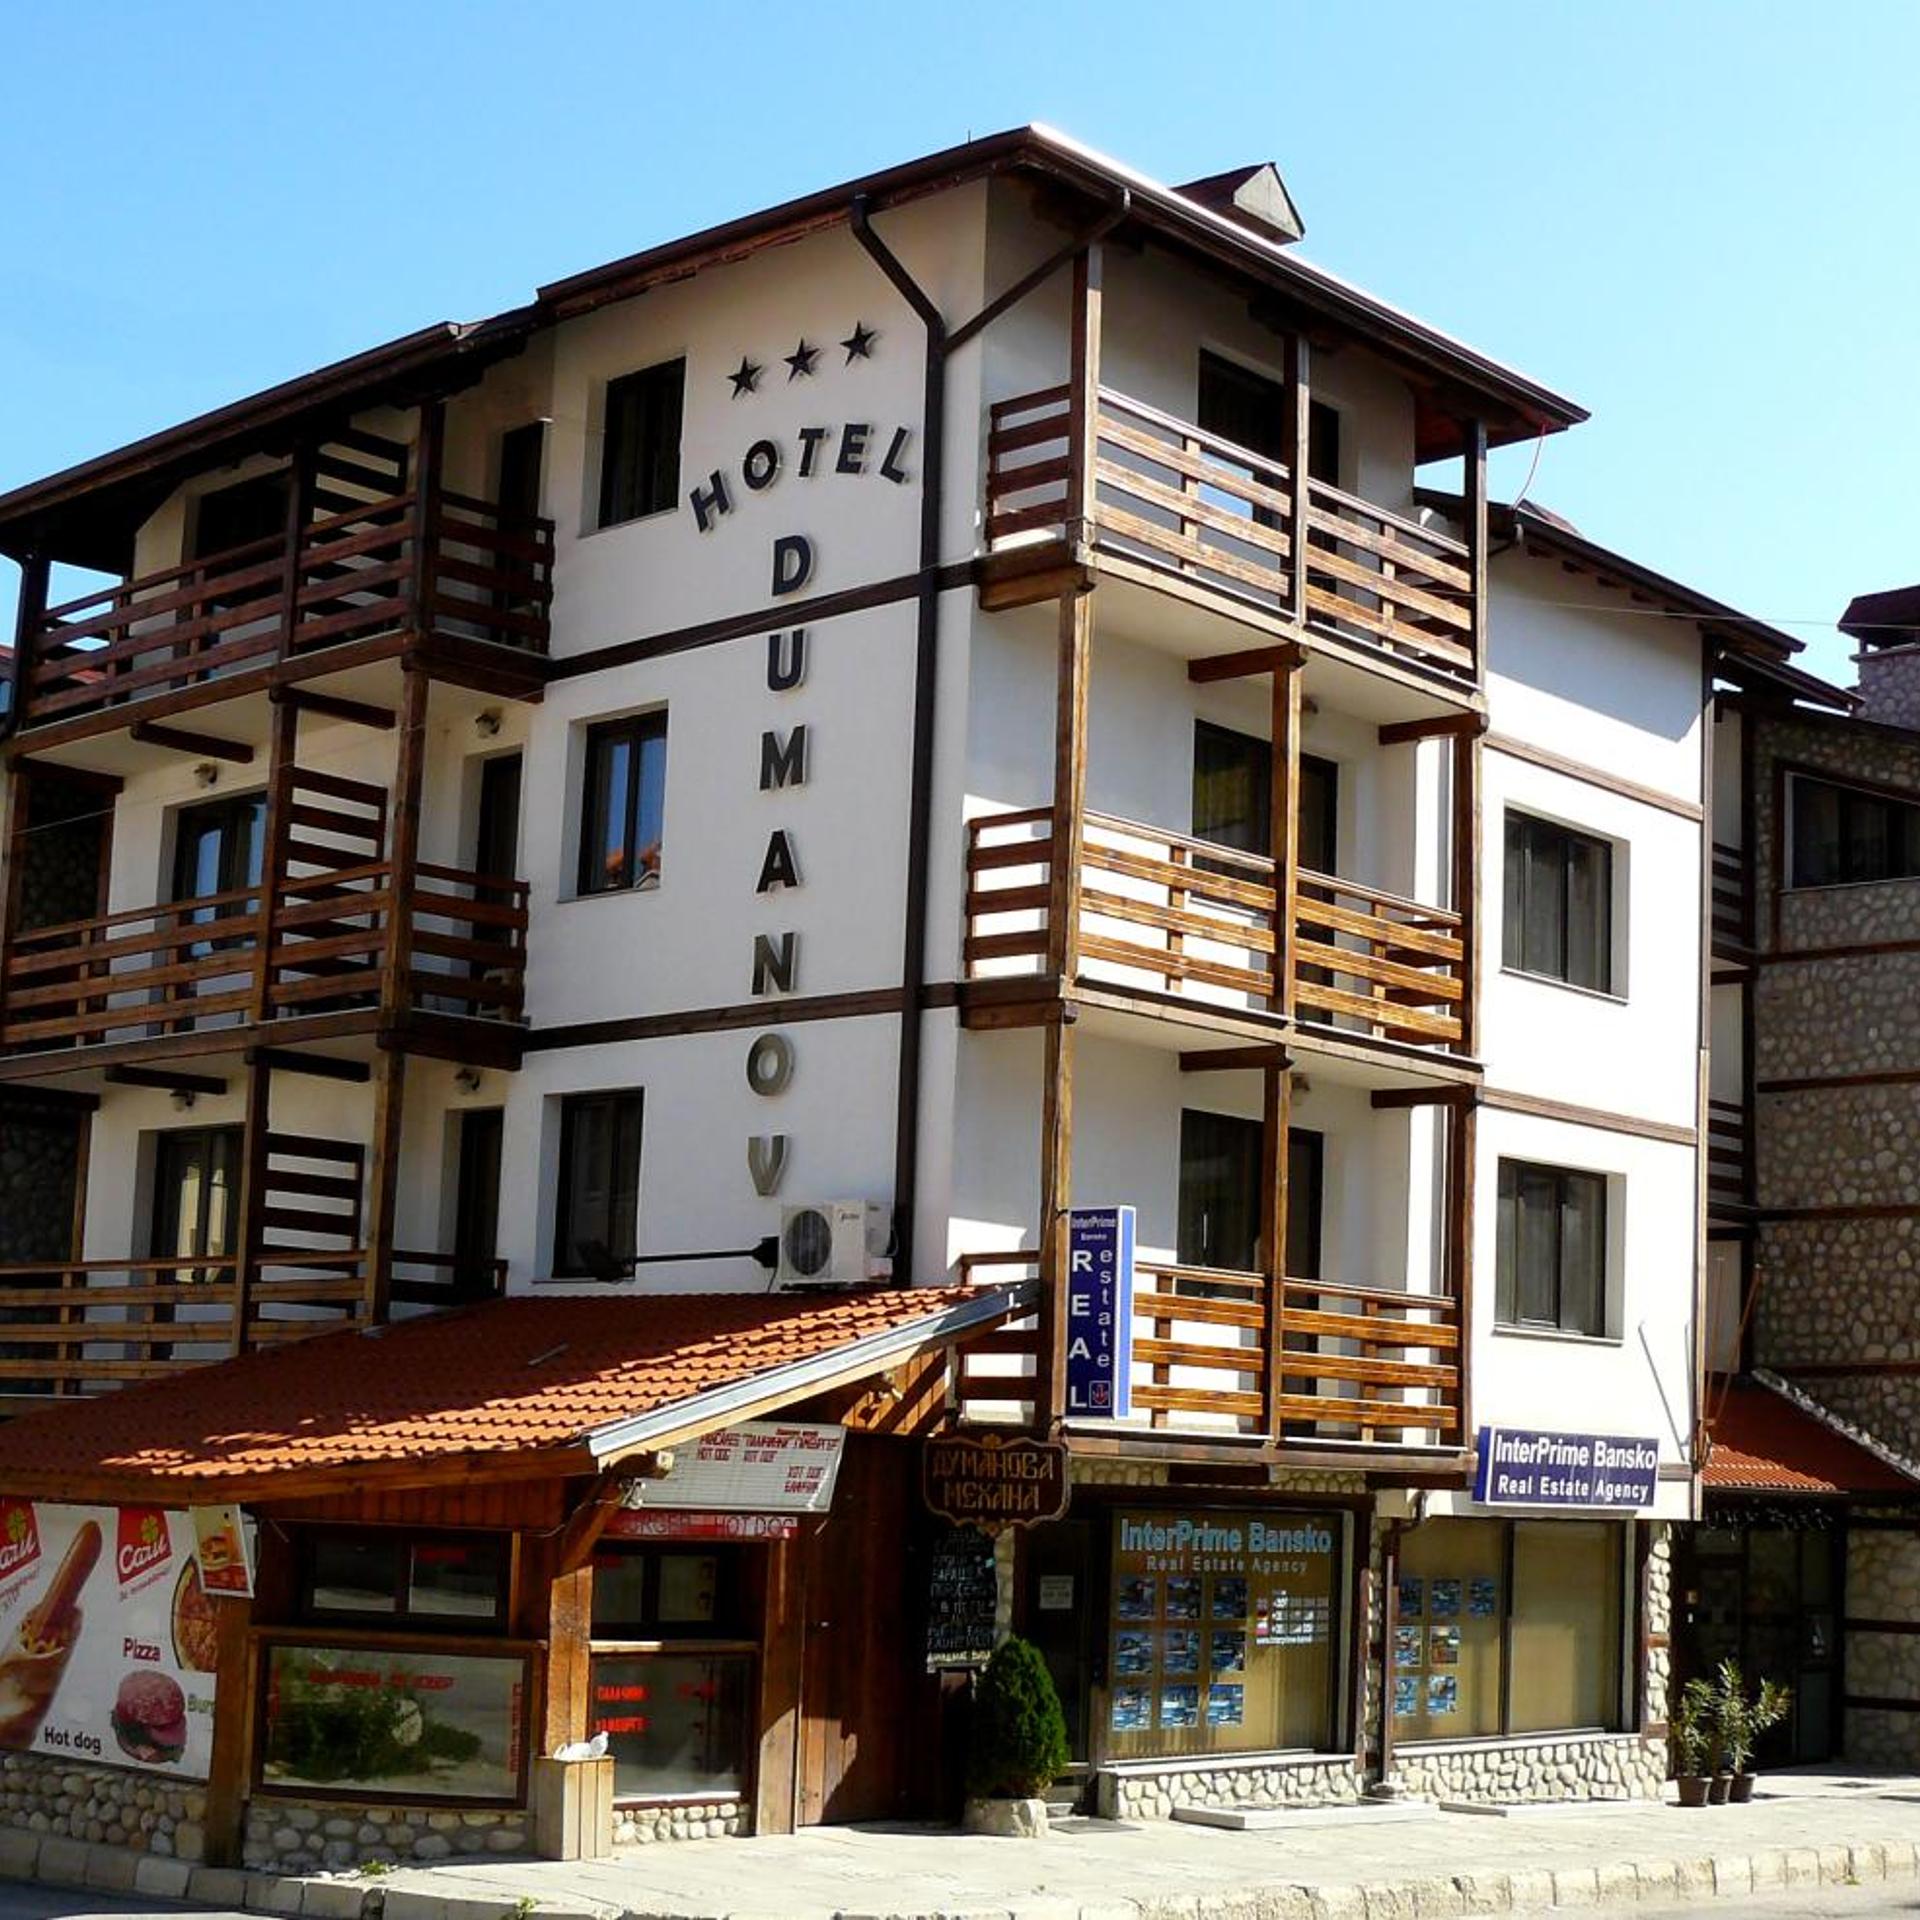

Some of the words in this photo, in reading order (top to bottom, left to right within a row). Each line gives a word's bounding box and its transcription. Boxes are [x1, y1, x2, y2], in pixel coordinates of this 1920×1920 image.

[689, 423, 909, 533] HOTEL
[747, 534, 812, 1197] DUMANOV
[1096, 1250, 1114, 1368] estate
[1068, 1250, 1093, 1408] REAL
[1495, 1434, 1590, 1467] InterPrime
[1593, 1440, 1657, 1470] Bansko
[943, 1481, 1040, 1512] МЕХАНА
[1498, 1474, 1533, 1495] Real
[1540, 1476, 1589, 1497] Estate
[1595, 1479, 1649, 1503] Agency
[1121, 1518, 1242, 1551] InterPrime
[1249, 1521, 1332, 1554] Bansko
[1146, 1555, 1184, 1571] Real
[1192, 1556, 1245, 1572] Estate
[1252, 1556, 1308, 1574] Agency
[123, 1637, 161, 1662] Pizza
[44, 1726, 70, 1748] Hot
[74, 1731, 102, 1756] dog
